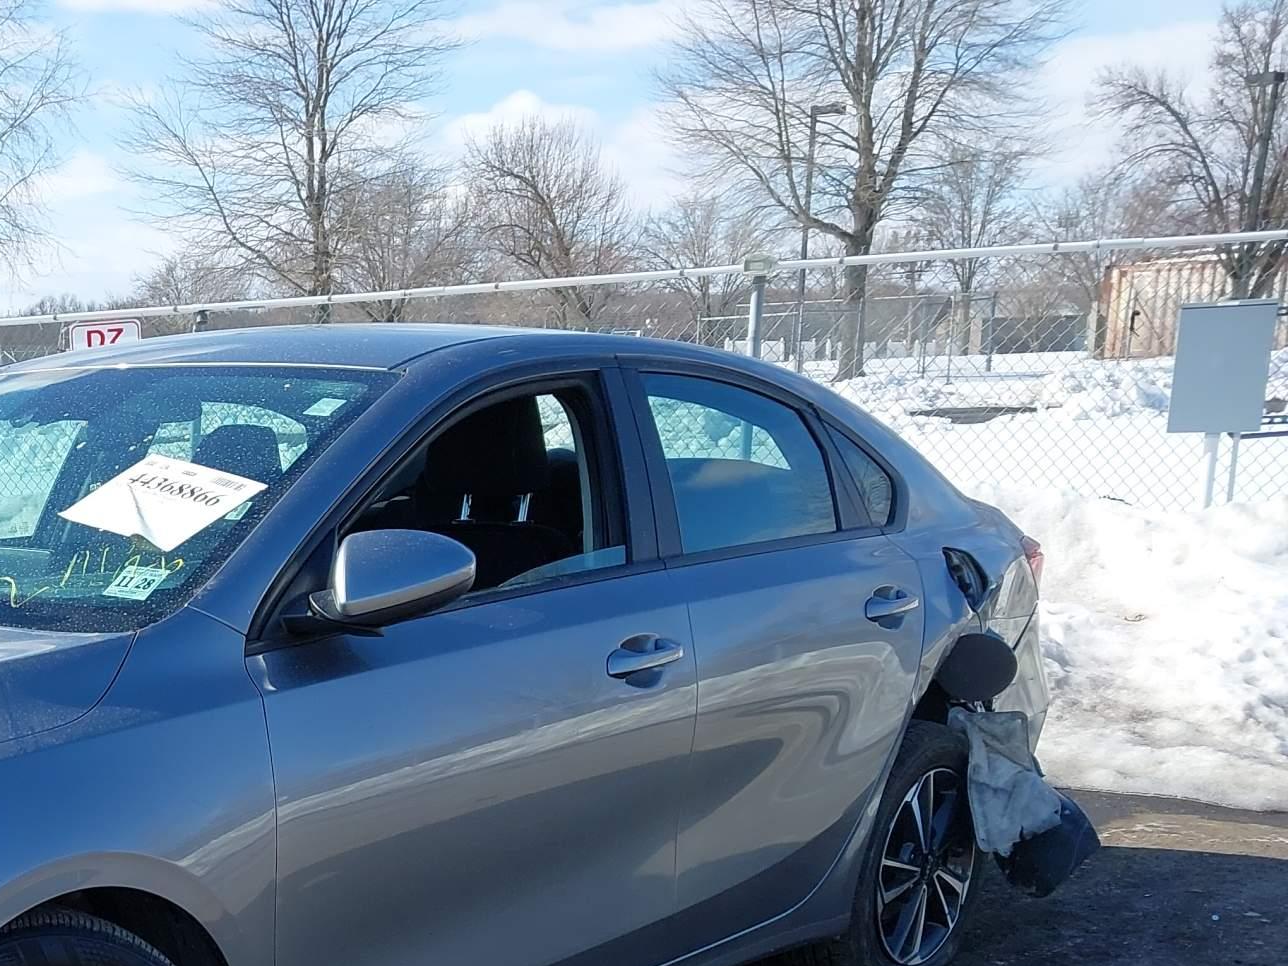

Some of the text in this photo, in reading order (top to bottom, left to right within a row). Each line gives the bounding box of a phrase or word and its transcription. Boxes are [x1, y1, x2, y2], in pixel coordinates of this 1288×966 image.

[128, 473, 229, 507] 44368866
[115, 575, 155, 590] 11 28
